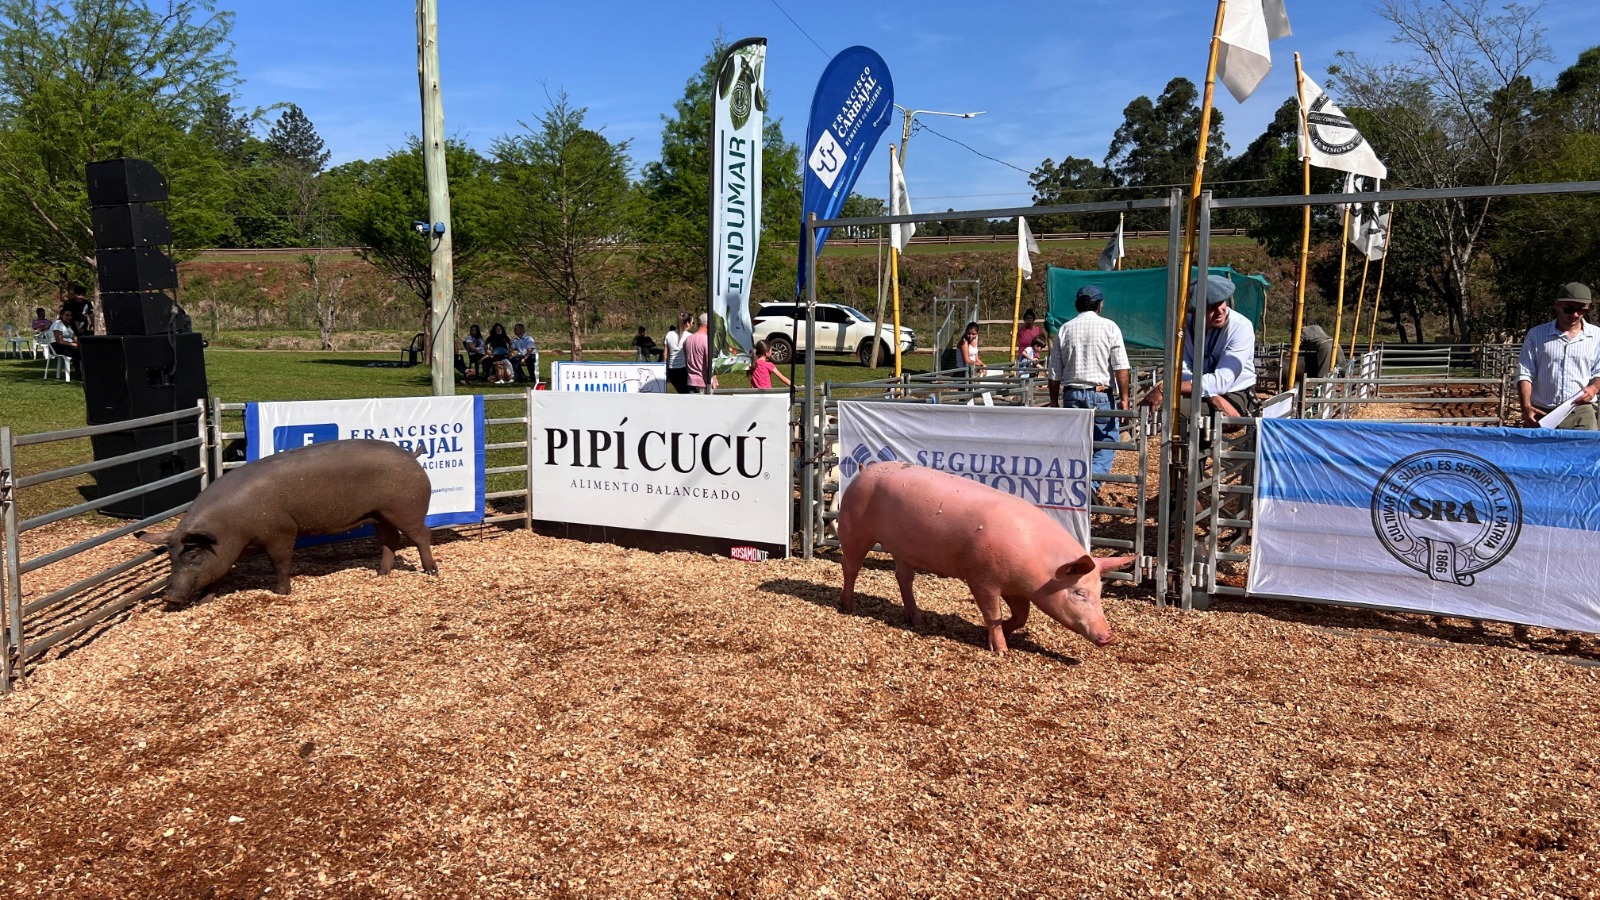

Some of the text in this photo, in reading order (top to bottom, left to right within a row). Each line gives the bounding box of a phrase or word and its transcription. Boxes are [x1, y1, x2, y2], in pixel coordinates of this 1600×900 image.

[832, 66, 870, 130] FRANCISCO
[838, 75, 877, 138] CARBAJAL
[845, 119, 863, 147] REMATES
[865, 85, 883, 113] HACIENDA
[727, 136, 746, 295] INDUMAR
[566, 369, 627, 380] CABAÑA TEXEL
[351, 422, 463, 440] FRANCISCO
[398, 436, 463, 459] BAJAL
[544, 416, 767, 479] PIPÍ CUCÚ
[422, 459, 464, 470] ACIENDA
[917, 450, 1088, 480] SEGURIDAD
[570, 479, 740, 501] ALIMENTO BALANCEADO
[1383, 460, 1508, 549] CULTIVAR EL SUELO ES SERVIR A LA PATRIA
[1408, 497, 1482, 525] SRA
[731, 547, 770, 561] ROSAMONTE
[1435, 549, 1448, 574] 1866
